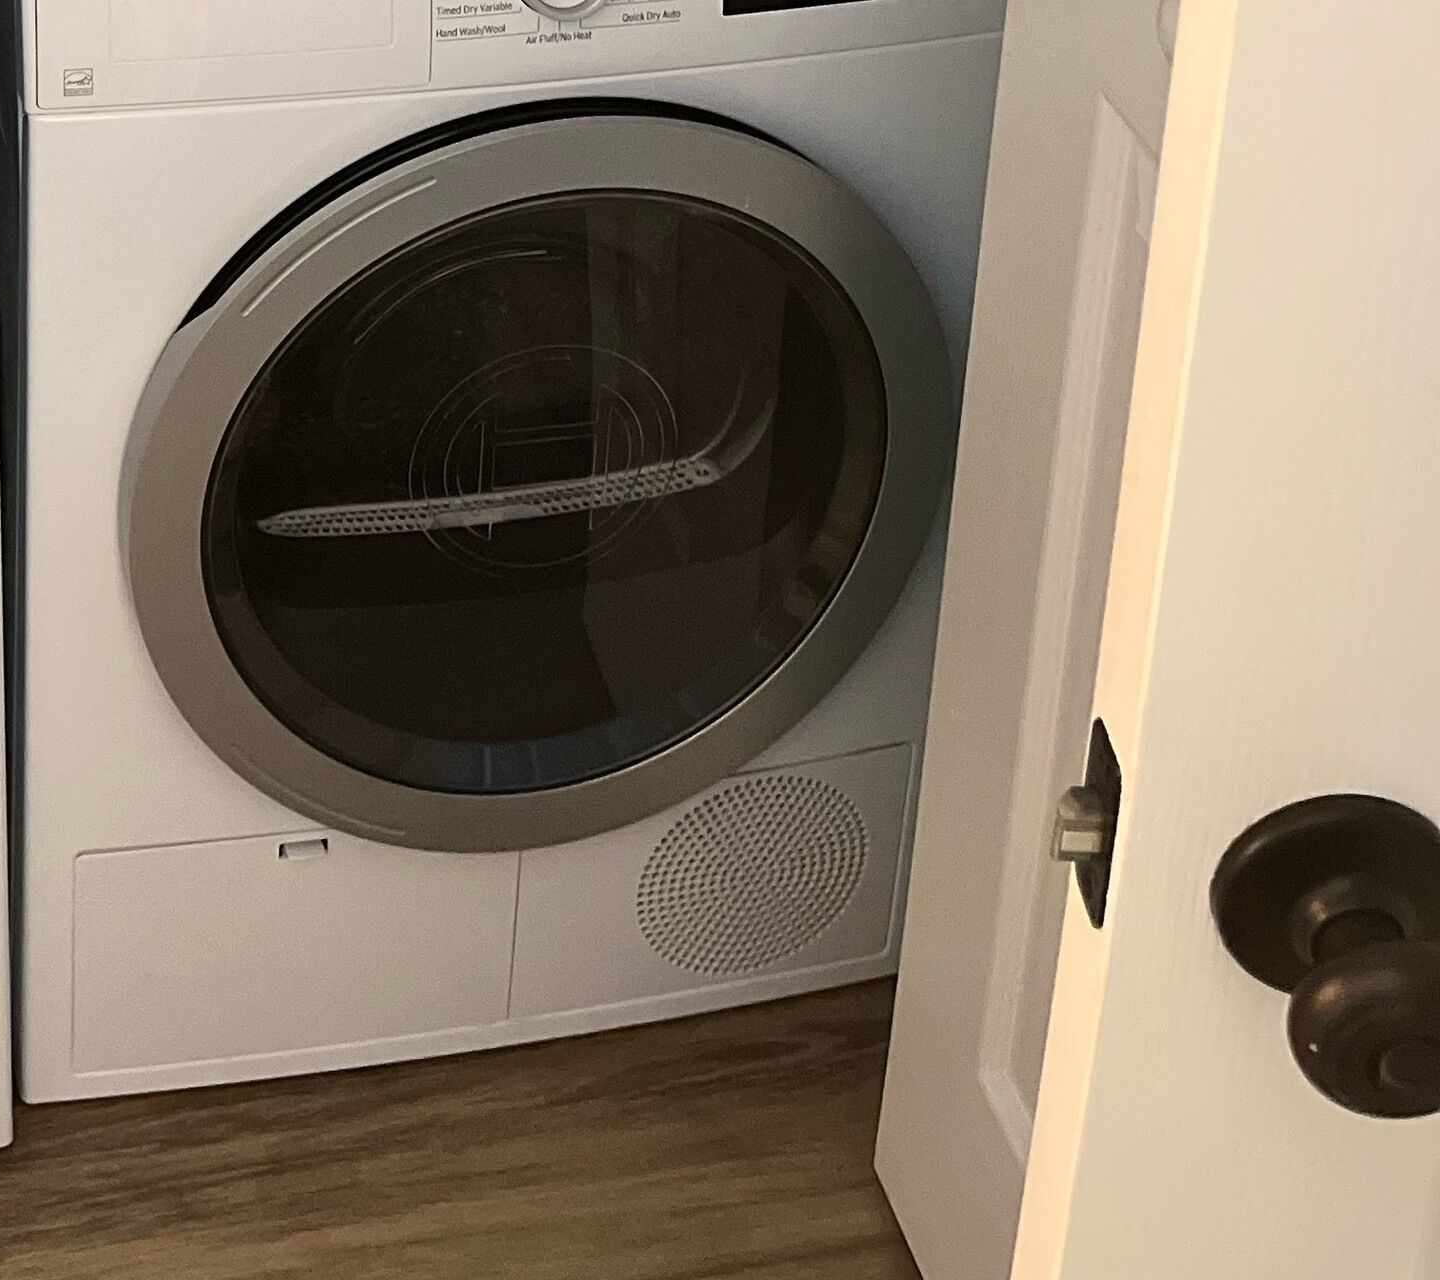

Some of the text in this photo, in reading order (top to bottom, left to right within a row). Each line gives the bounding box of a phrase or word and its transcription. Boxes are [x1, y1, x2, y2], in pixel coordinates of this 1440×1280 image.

[436, 2, 513, 16] Timed Dry Variable
[622, 9, 681, 22] Quick Dry Auto
[436, 24, 506, 38] Hand Wash/Wool
[526, 31, 593, 45] Air Fluff/No Heat
